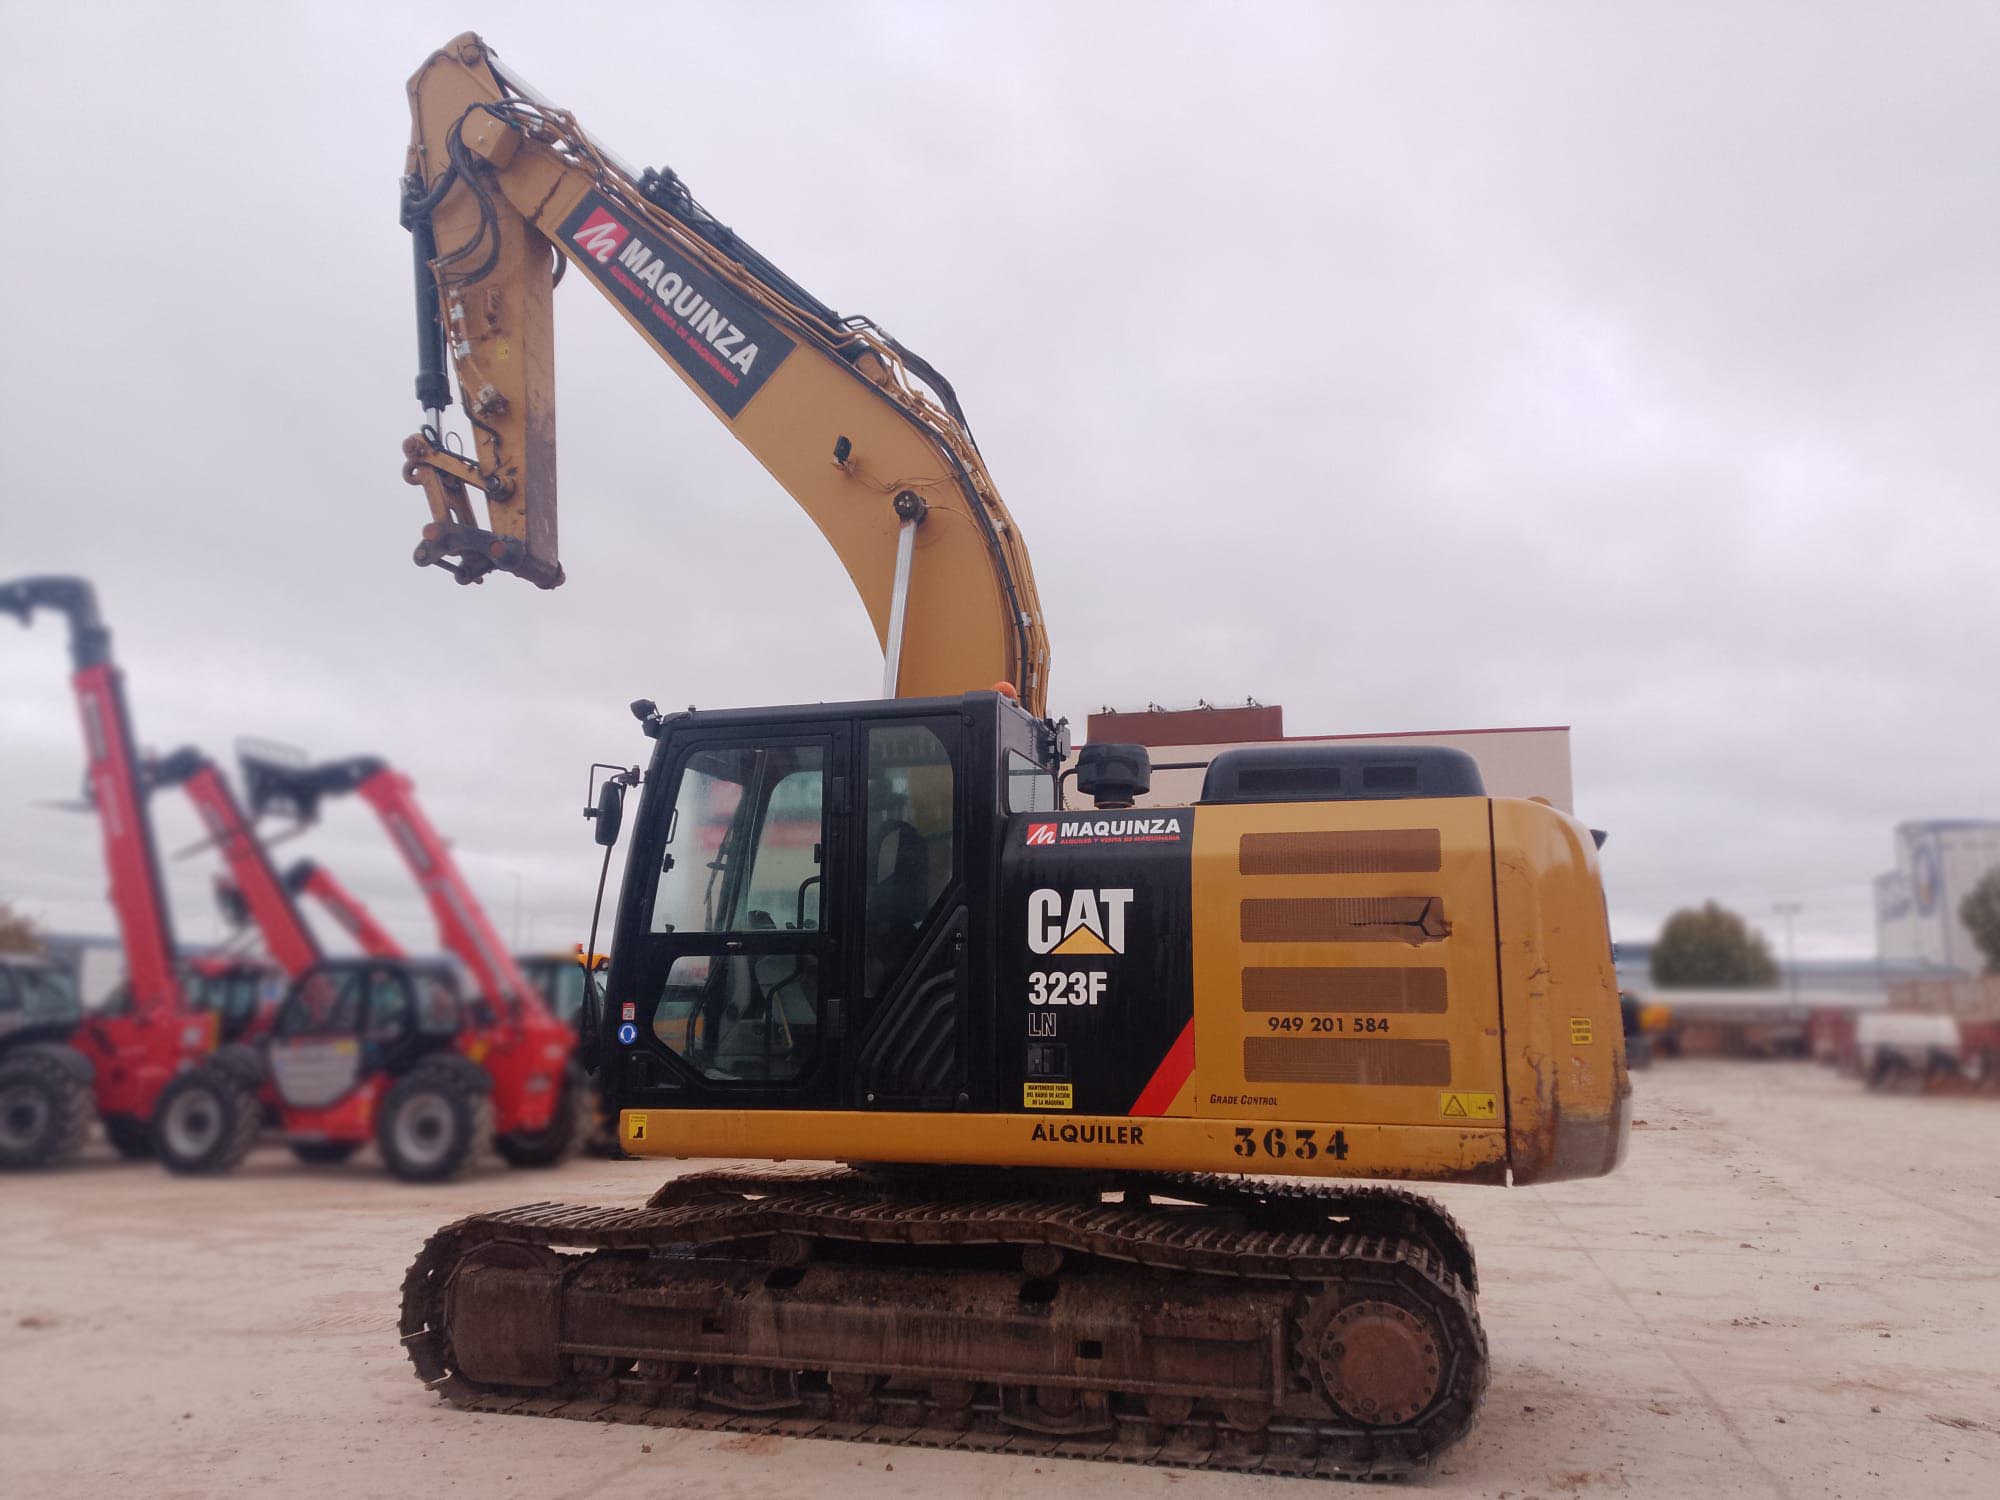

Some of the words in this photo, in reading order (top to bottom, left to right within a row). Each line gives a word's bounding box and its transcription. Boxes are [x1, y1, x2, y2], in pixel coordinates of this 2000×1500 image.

[618, 237, 760, 376] MAQUINZA
[1060, 818, 1181, 837] MAQUINZA
[1028, 888, 1134, 955] CAT
[1028, 971, 1108, 1006] 323F
[1028, 1012, 1057, 1037] LN
[1267, 1016, 1304, 1032] 949
[1310, 1017, 1344, 1033] 201
[1353, 1017, 1390, 1033] 584
[1031, 1123, 1145, 1145] ALQUILER
[1234, 1126, 1349, 1161] 3634
